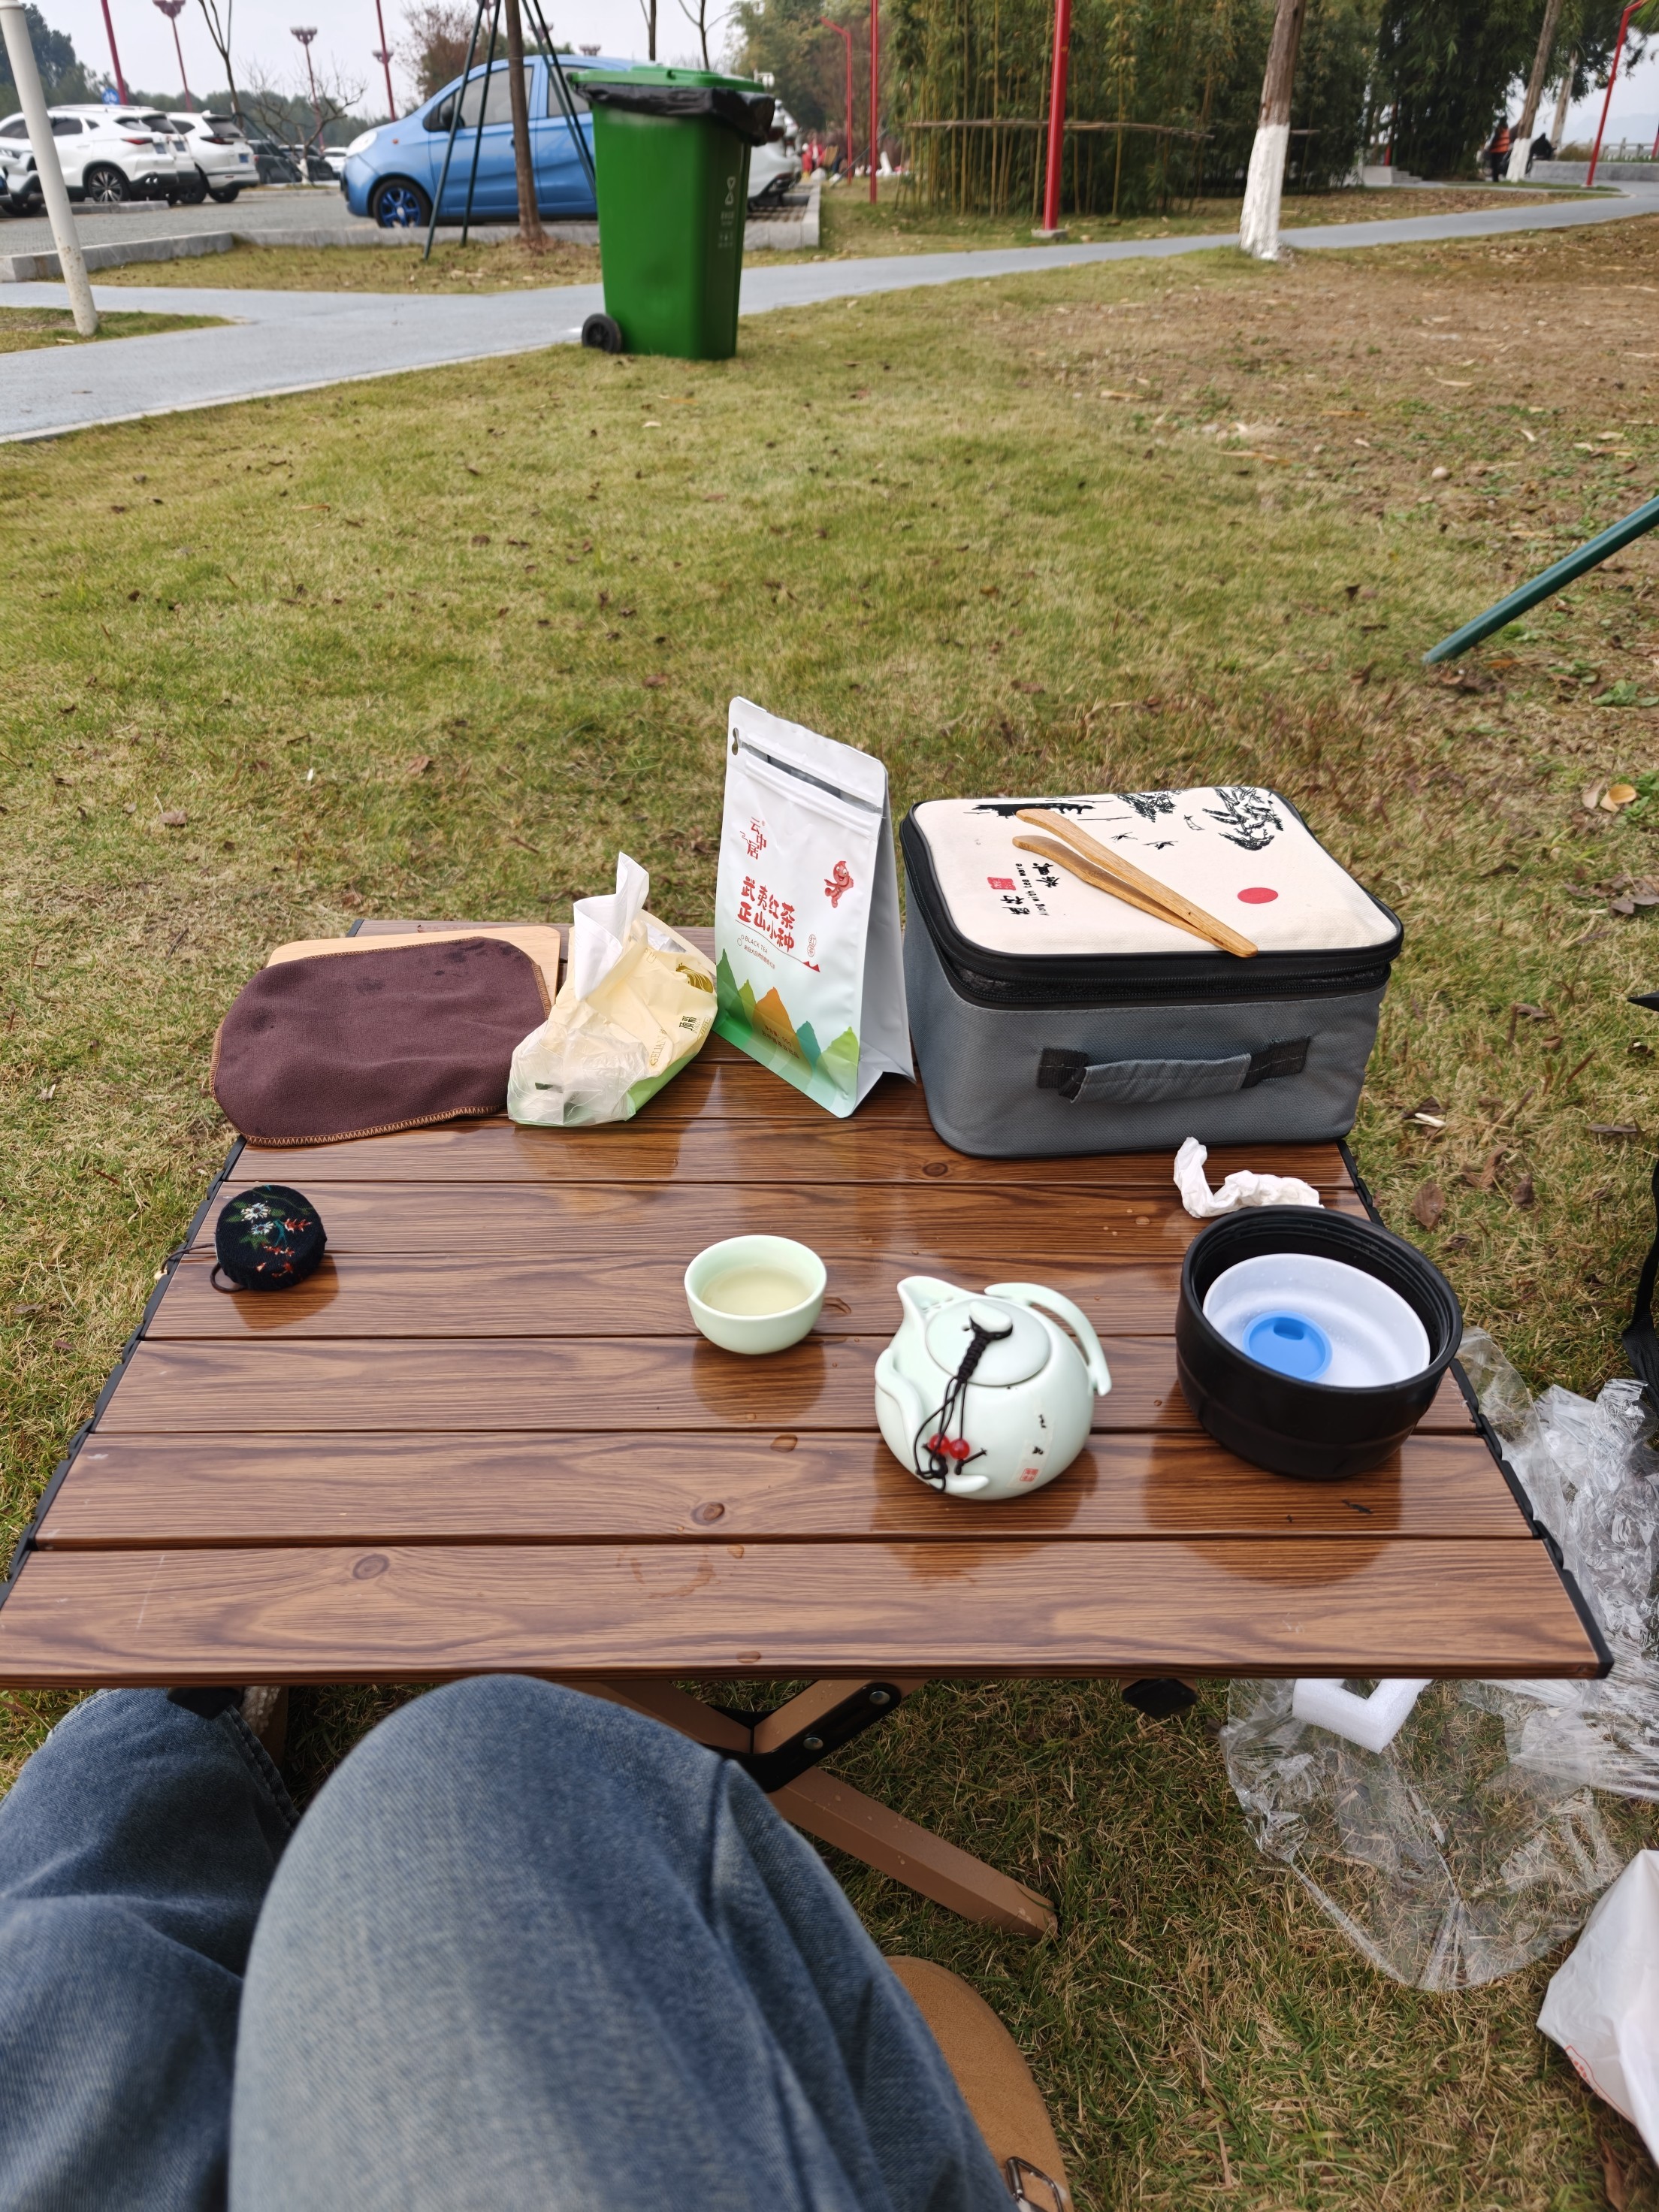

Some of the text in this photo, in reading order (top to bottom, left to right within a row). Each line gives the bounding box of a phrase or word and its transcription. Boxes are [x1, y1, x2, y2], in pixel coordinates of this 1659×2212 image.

[739, 816, 767, 860] 云中居
[1015, 863, 1026, 877] ware
[1022, 879, 1032, 888] tea
[741, 875, 796, 930] 武夷红茶
[1025, 890, 1040, 902] with
[737, 901, 795, 953] 正山小种
[745, 935, 760, 947] BLACK
